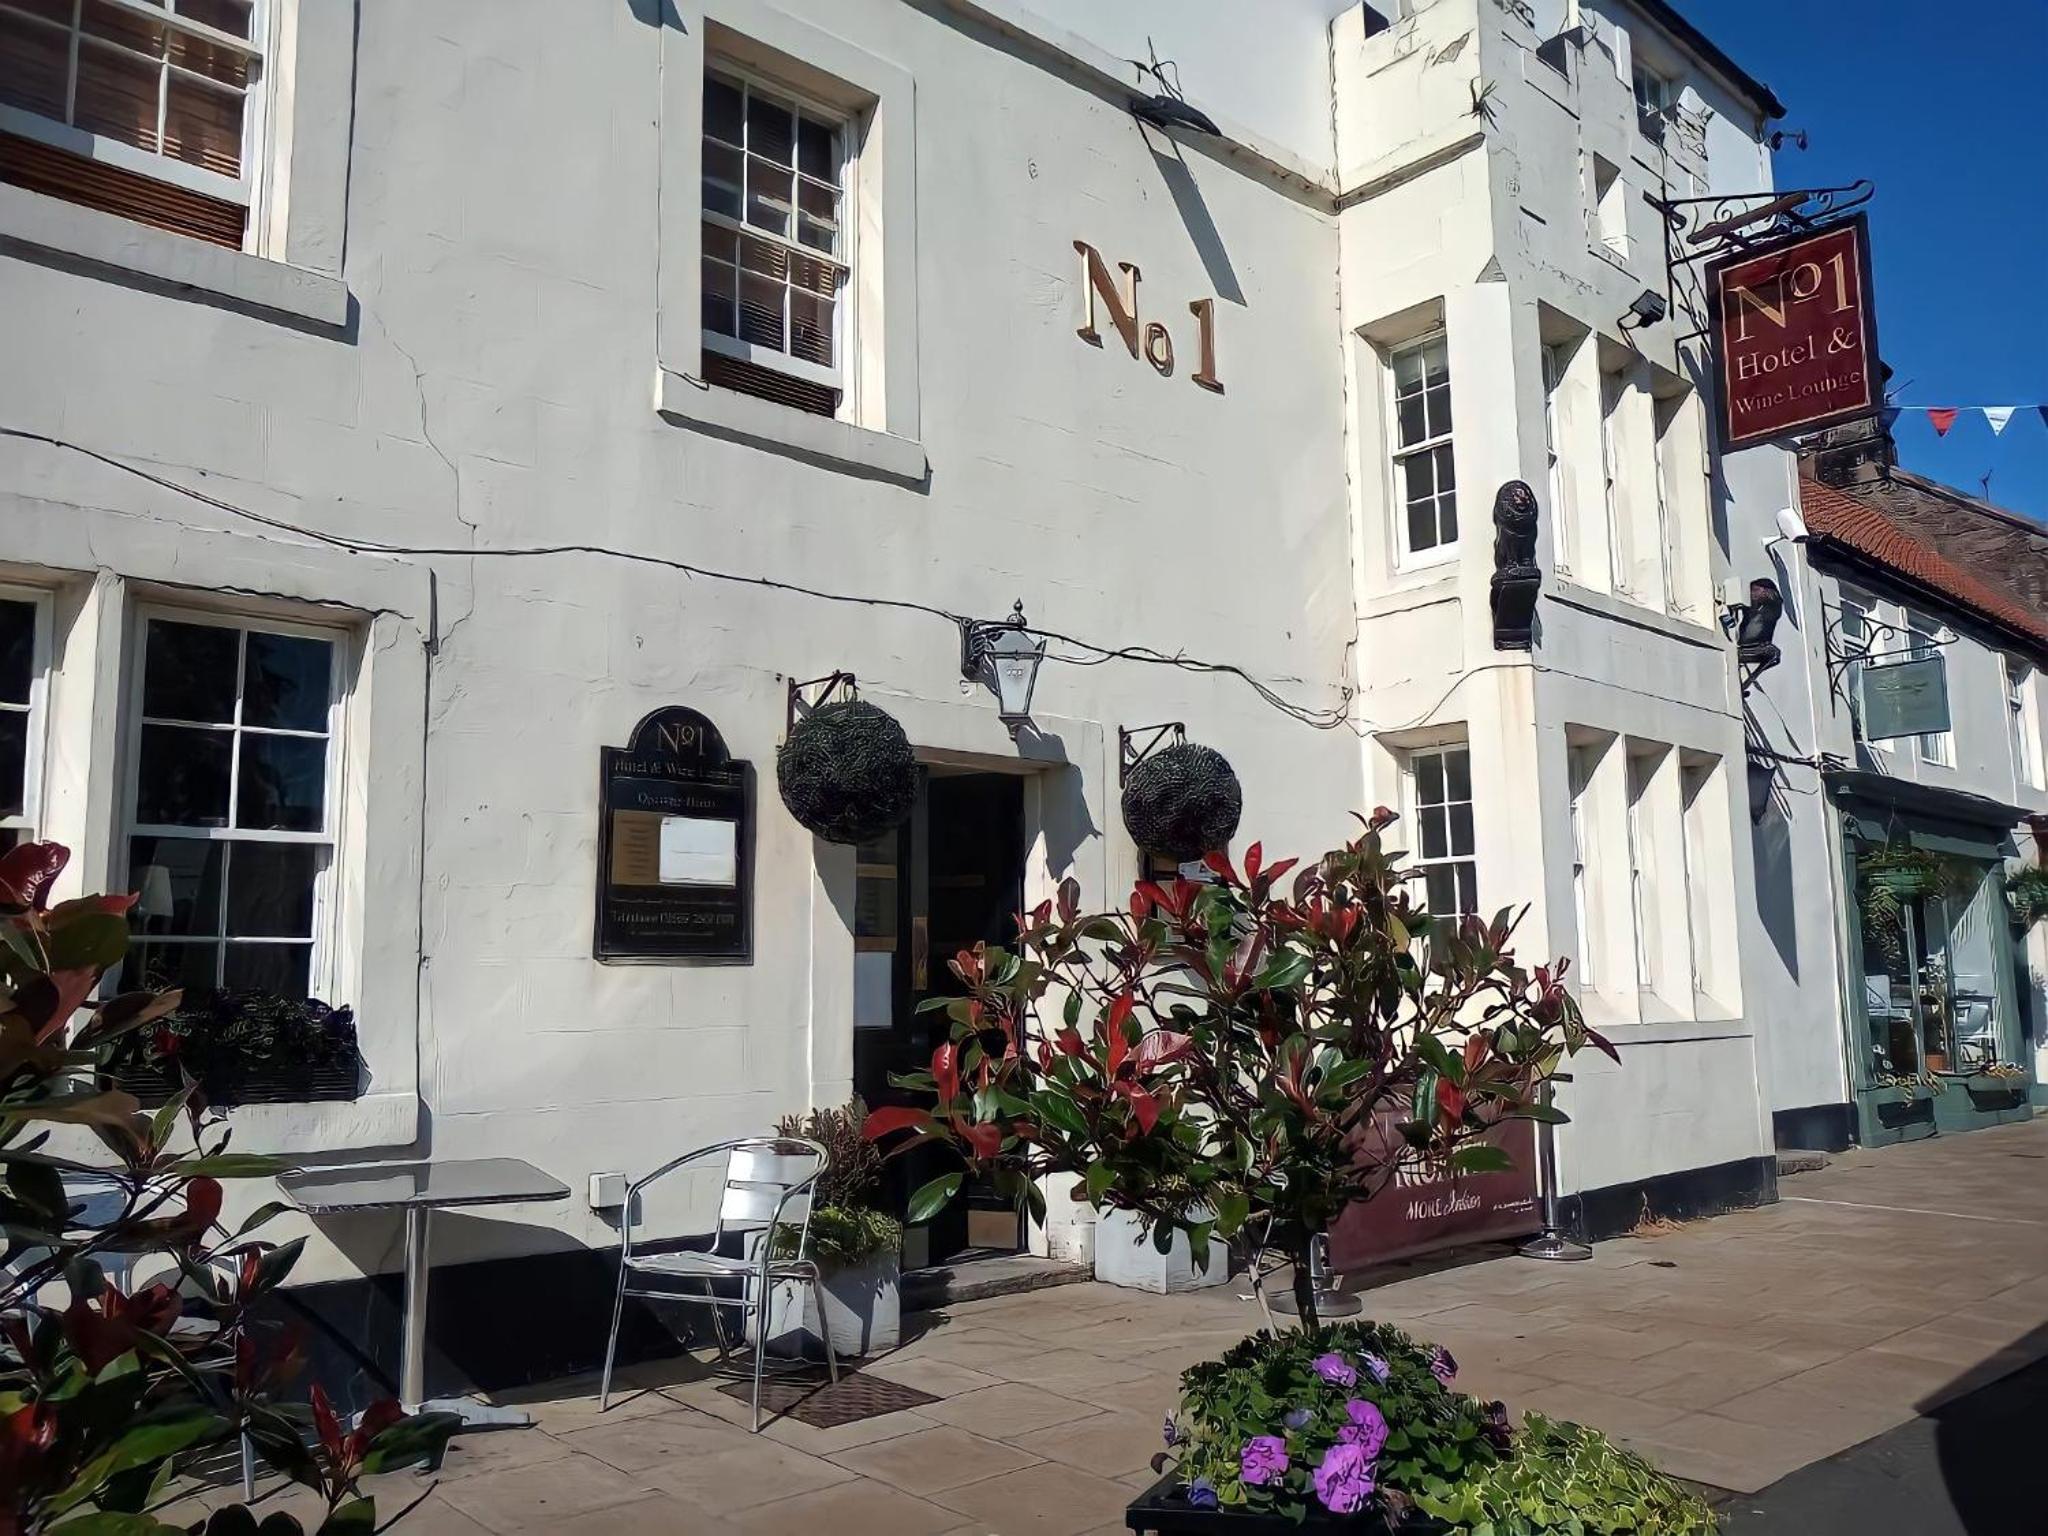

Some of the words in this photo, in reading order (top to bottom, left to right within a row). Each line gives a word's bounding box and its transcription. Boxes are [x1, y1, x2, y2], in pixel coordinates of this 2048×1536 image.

[1738, 334, 1816, 380] Hotel
[1827, 327, 1856, 354] &
[1736, 393, 1783, 414] Wine
[1788, 371, 1861, 401] Lounge
